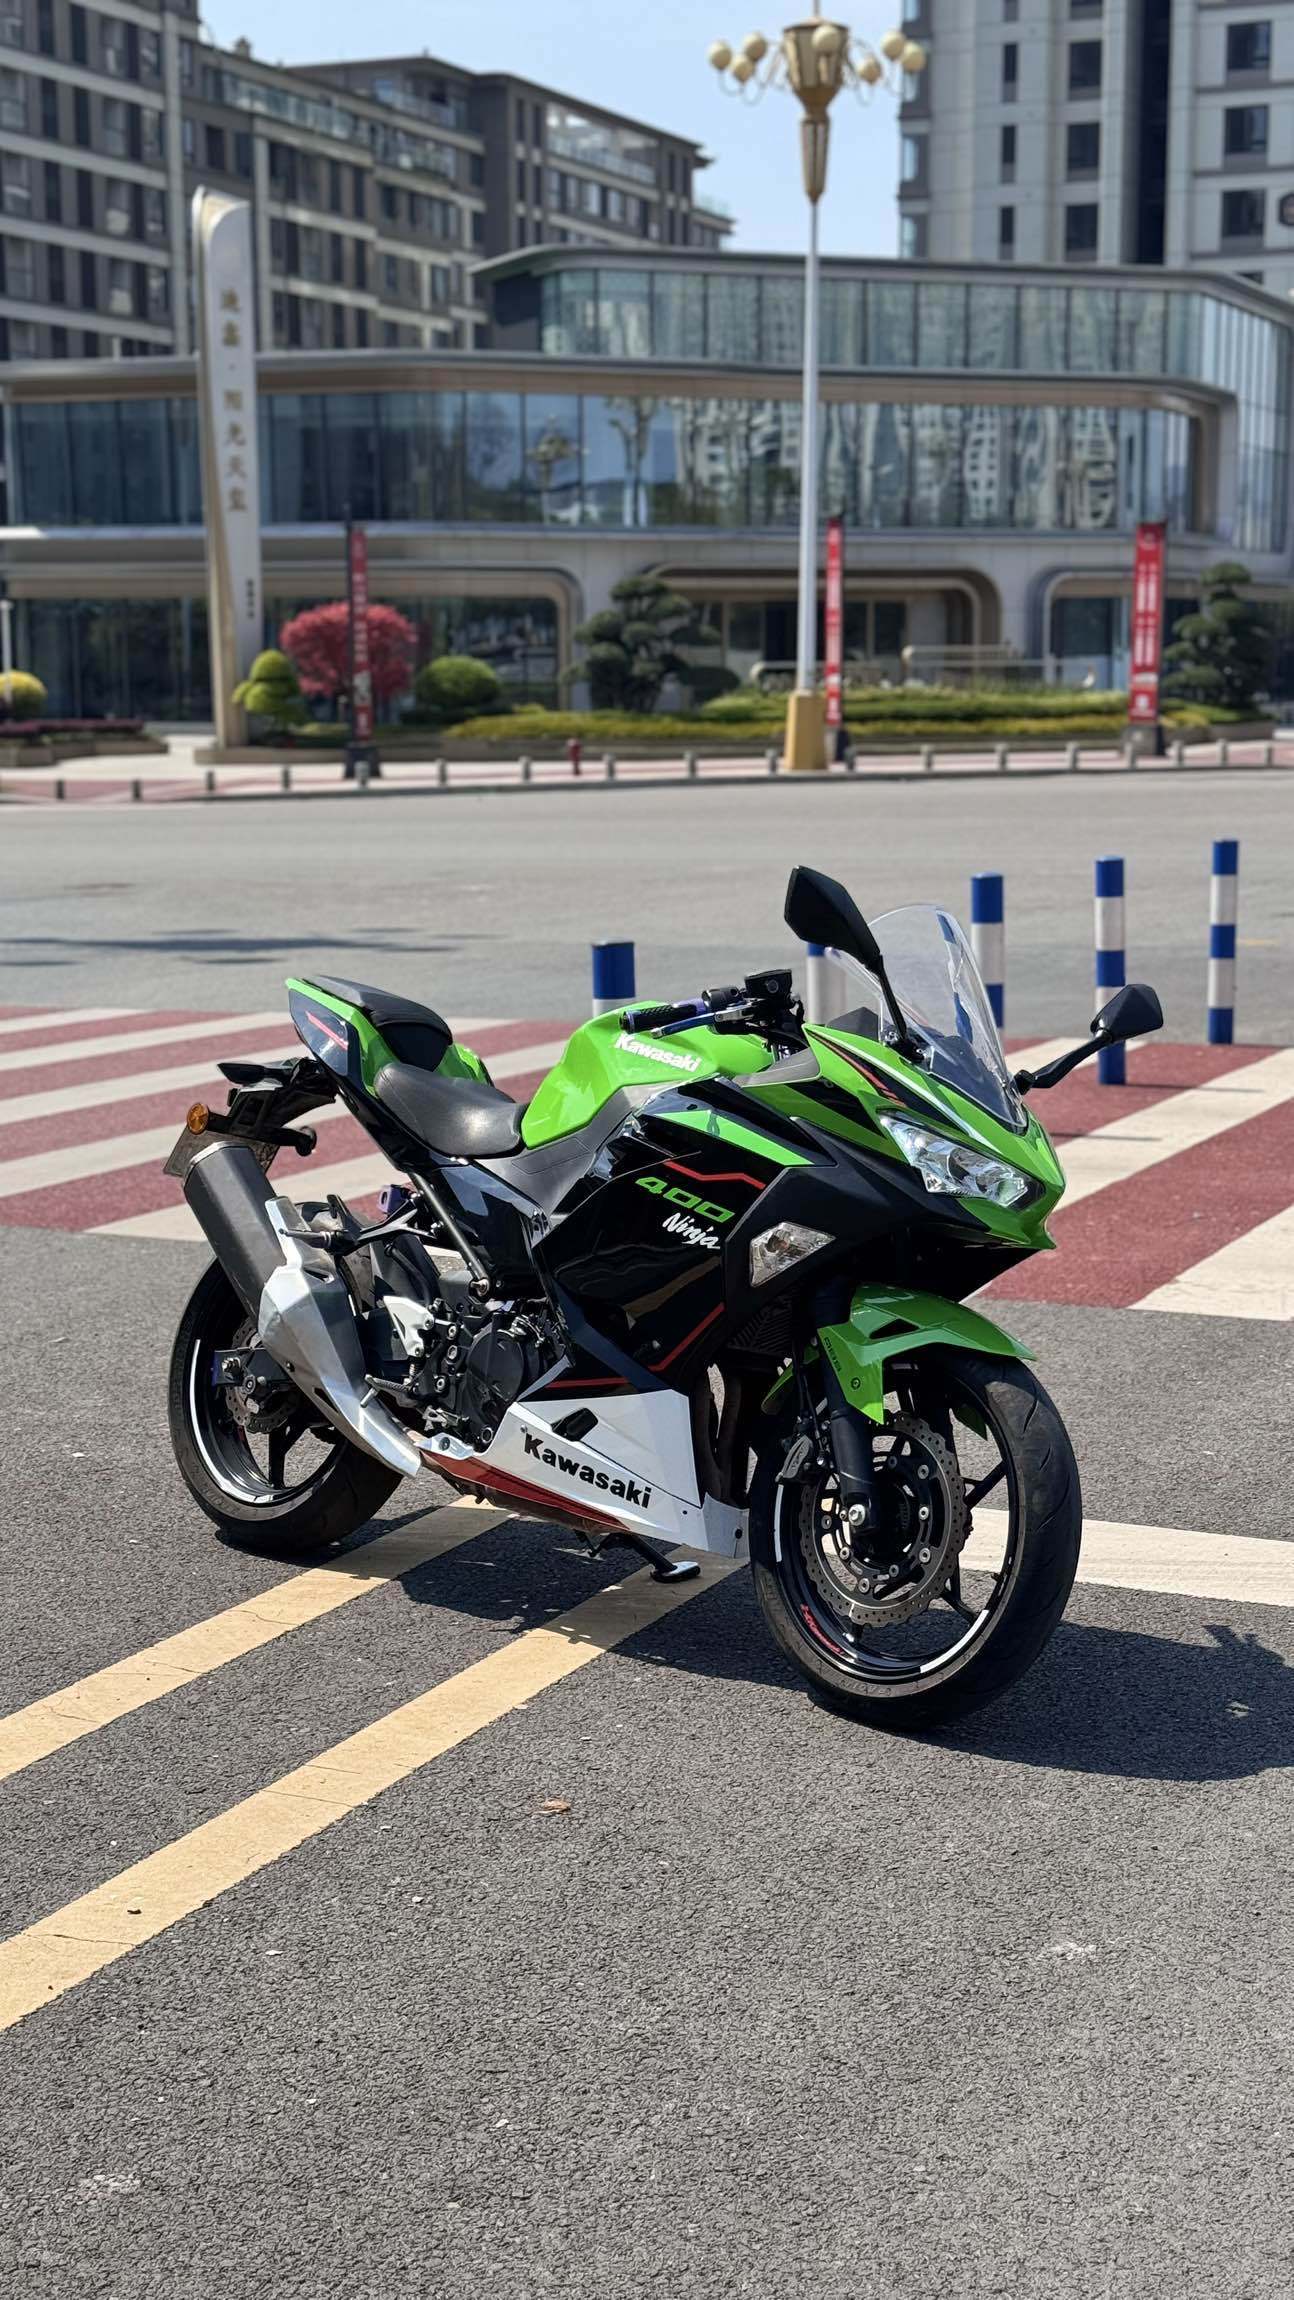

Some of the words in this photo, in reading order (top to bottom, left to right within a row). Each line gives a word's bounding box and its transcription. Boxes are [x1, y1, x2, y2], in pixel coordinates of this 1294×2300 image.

[614, 1031, 703, 1073] Kawasaki
[635, 1176, 736, 1223] 400
[661, 1212, 721, 1250] Ninja
[524, 1432, 652, 1509] Kawasaki
